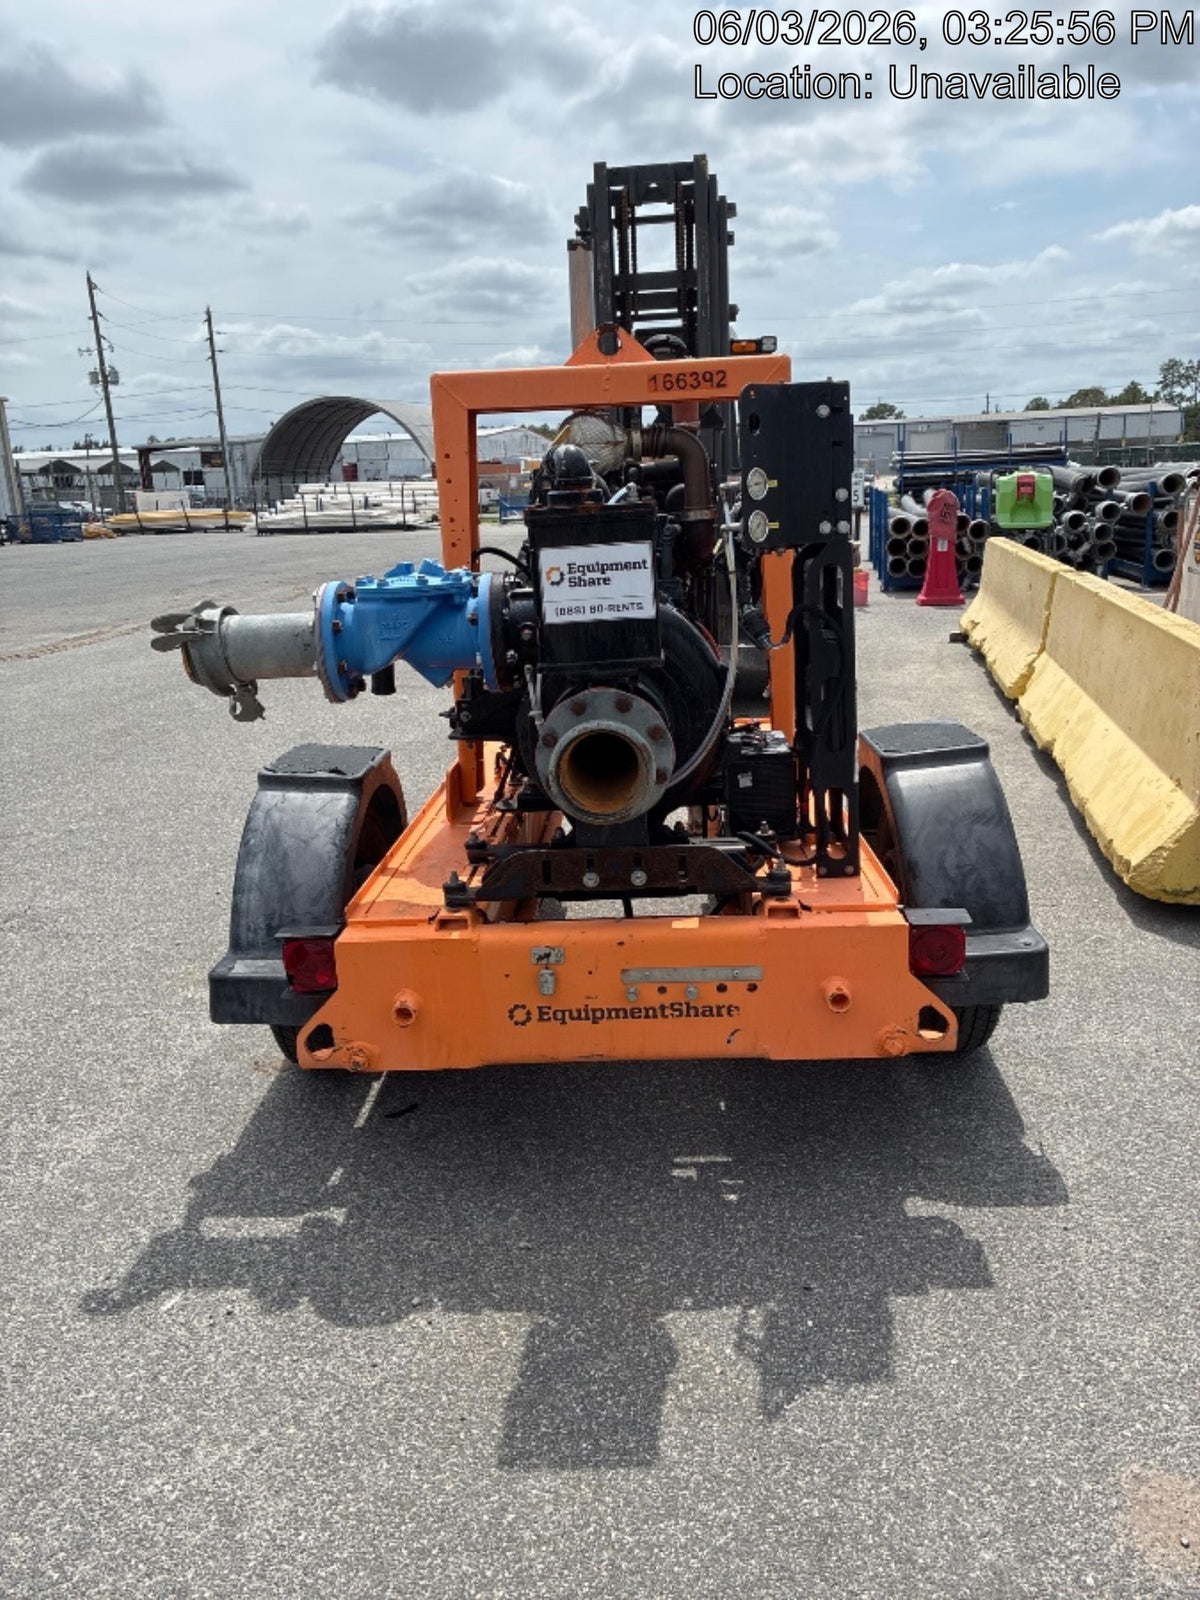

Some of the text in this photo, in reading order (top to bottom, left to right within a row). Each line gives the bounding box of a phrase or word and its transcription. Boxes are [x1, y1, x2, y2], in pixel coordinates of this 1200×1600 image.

[648, 369, 727, 391] 166392
[566, 558, 649, 576] Equipment
[568, 576, 611, 588] Share
